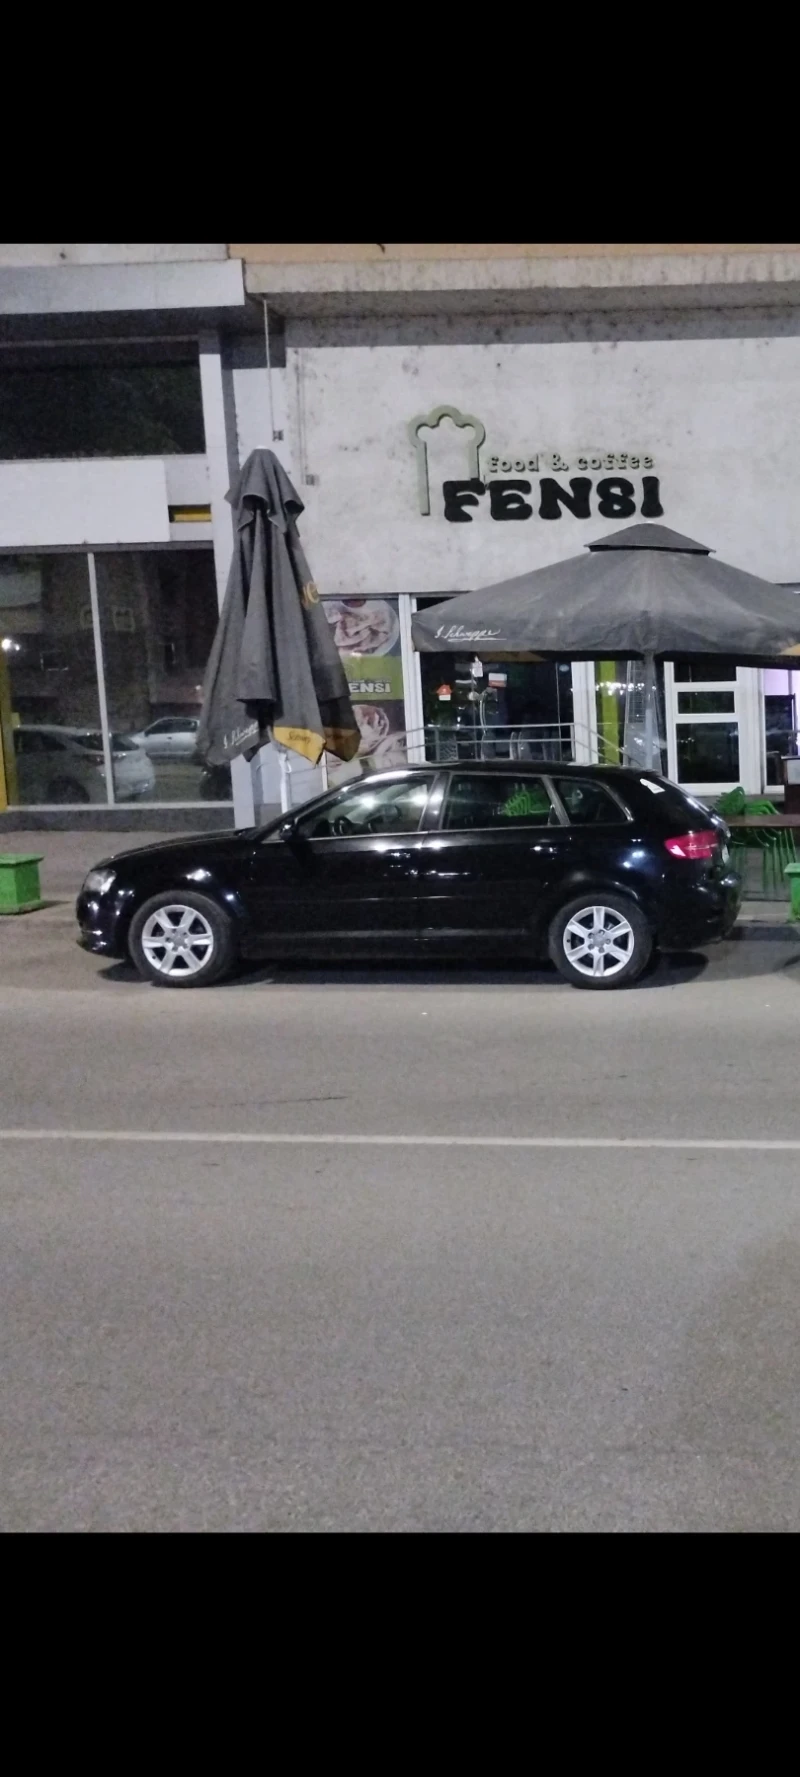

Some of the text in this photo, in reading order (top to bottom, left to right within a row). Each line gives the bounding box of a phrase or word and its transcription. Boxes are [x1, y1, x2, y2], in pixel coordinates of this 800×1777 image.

[488, 452, 655, 473] food & coffee
[348, 682, 391, 693] ENSI
